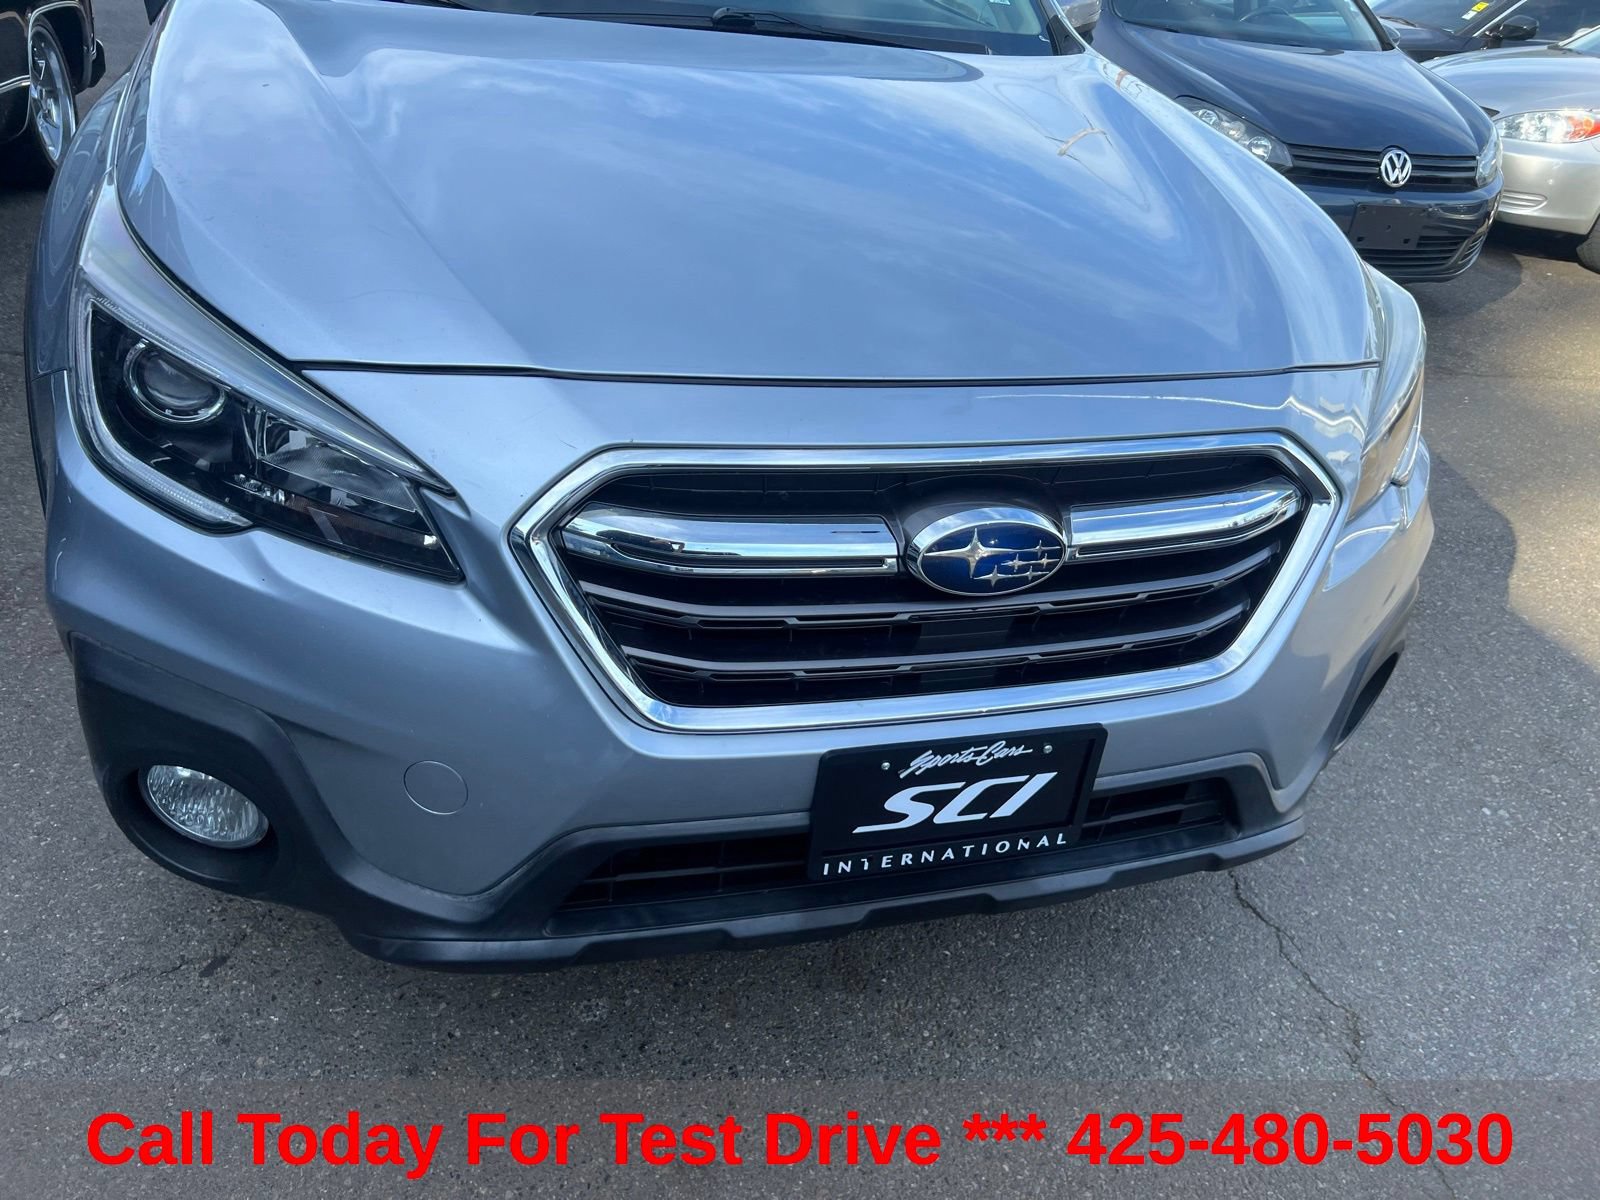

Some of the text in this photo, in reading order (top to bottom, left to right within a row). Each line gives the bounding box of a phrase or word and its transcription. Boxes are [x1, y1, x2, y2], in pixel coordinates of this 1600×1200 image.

[1381, 150, 1412, 188] VW
[900, 746, 988, 778] Sports
[852, 771, 1058, 834] SCI
[822, 832, 1067, 876] INTERNATIONAL
